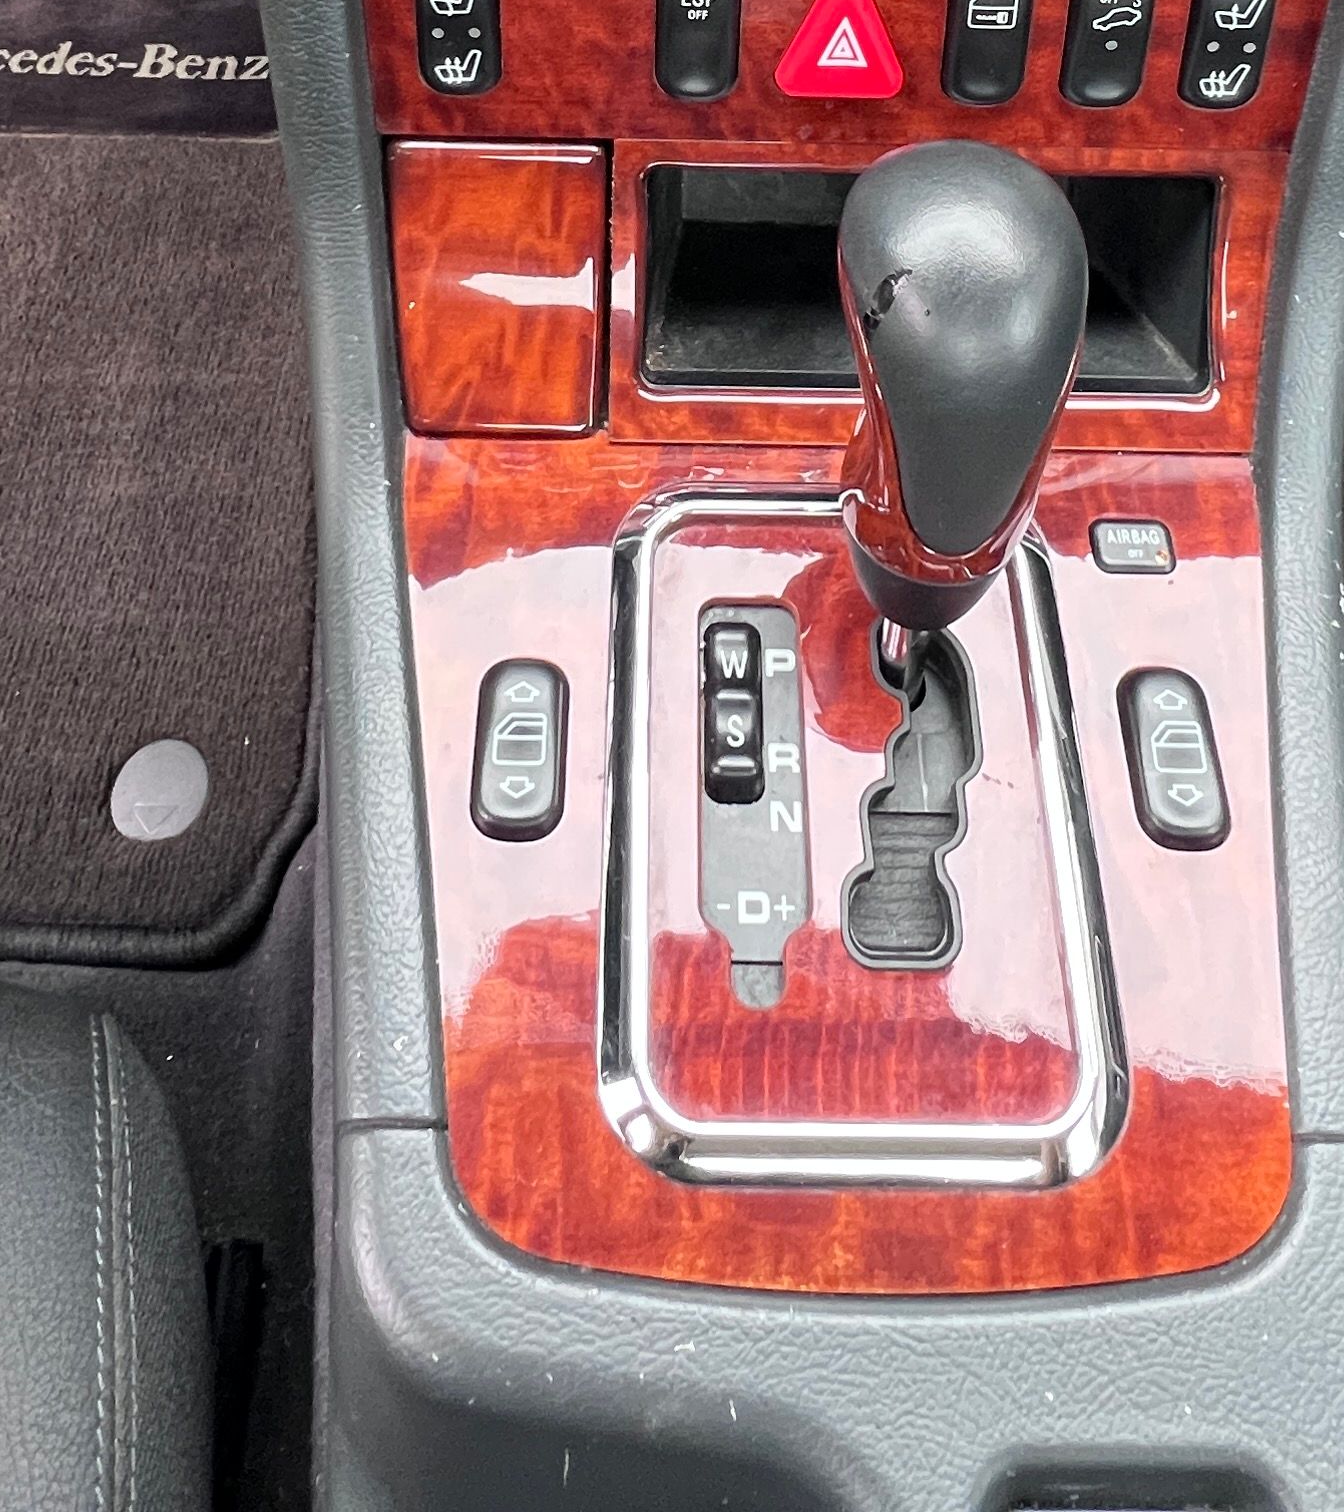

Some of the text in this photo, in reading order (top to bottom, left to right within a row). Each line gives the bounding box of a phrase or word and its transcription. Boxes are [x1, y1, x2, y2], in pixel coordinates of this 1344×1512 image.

[687, 9, 709, 21] OFF
[1107, 528, 1160, 545] AIRBAG
[720, 649, 748, 679] W
[765, 648, 796, 678] P
[726, 714, 746, 748] S
[768, 741, 801, 773] R
[770, 800, 803, 833] N
